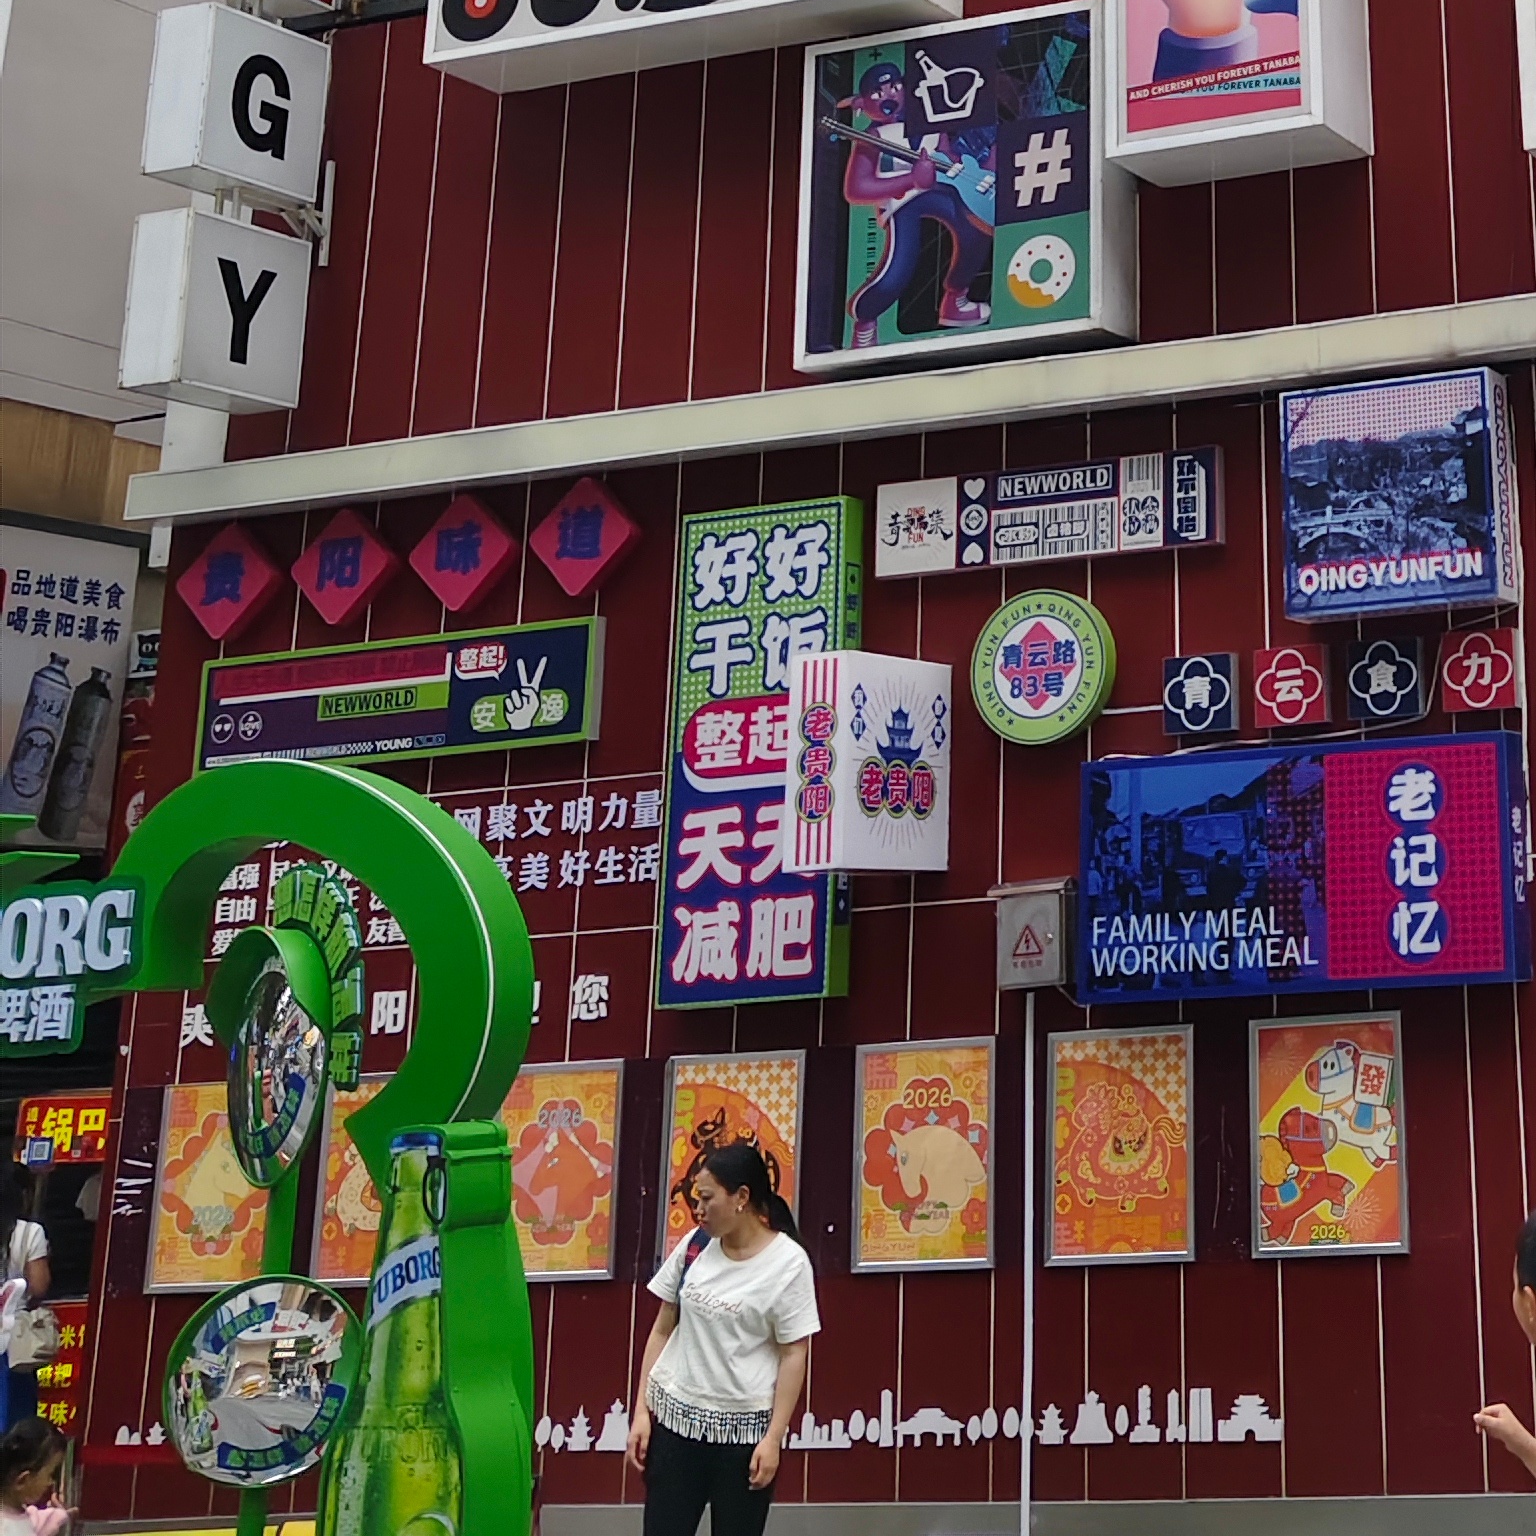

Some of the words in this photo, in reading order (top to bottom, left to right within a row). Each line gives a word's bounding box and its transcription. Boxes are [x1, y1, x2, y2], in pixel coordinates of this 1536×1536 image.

[1129, 88, 1150, 101] AND
[1151, 79, 1194, 96] CHERISH
[1195, 73, 1216, 86] YOU
[1217, 64, 1262, 81] FOREVER
[1217, 79, 1261, 92] FOREVER
[231, 52, 292, 162] G
[216, 256, 278, 367] Y
[1000, 466, 1110, 499] NEWWORLD
[691, 520, 832, 611] 好好
[11, 568, 126, 612] 品地道美食
[689, 606, 830, 697] 干饭
[1001, 638, 1076, 669] 青云路
[321, 688, 415, 716] NEWWORLD
[1010, 670, 1065, 699] 83号
[374, 736, 414, 753] YOUNG
[802, 707, 835, 813] 老贵阳
[857, 760, 936, 811] 老贵阳
[1387, 766, 1442, 957] 老记忆
[214, 895, 258, 926] 自由
[1091, 909, 1195, 947] FAMILY
[1205, 904, 1285, 941] MEAL
[672, 894, 816, 984] 减肥
[1090, 938, 1230, 978] WORKING
[1237, 934, 1320, 970] MEAL
[536, 1106, 584, 1130] 2026
[902, 1085, 953, 1111] 2026
[1309, 1223, 1347, 1242] 2026
